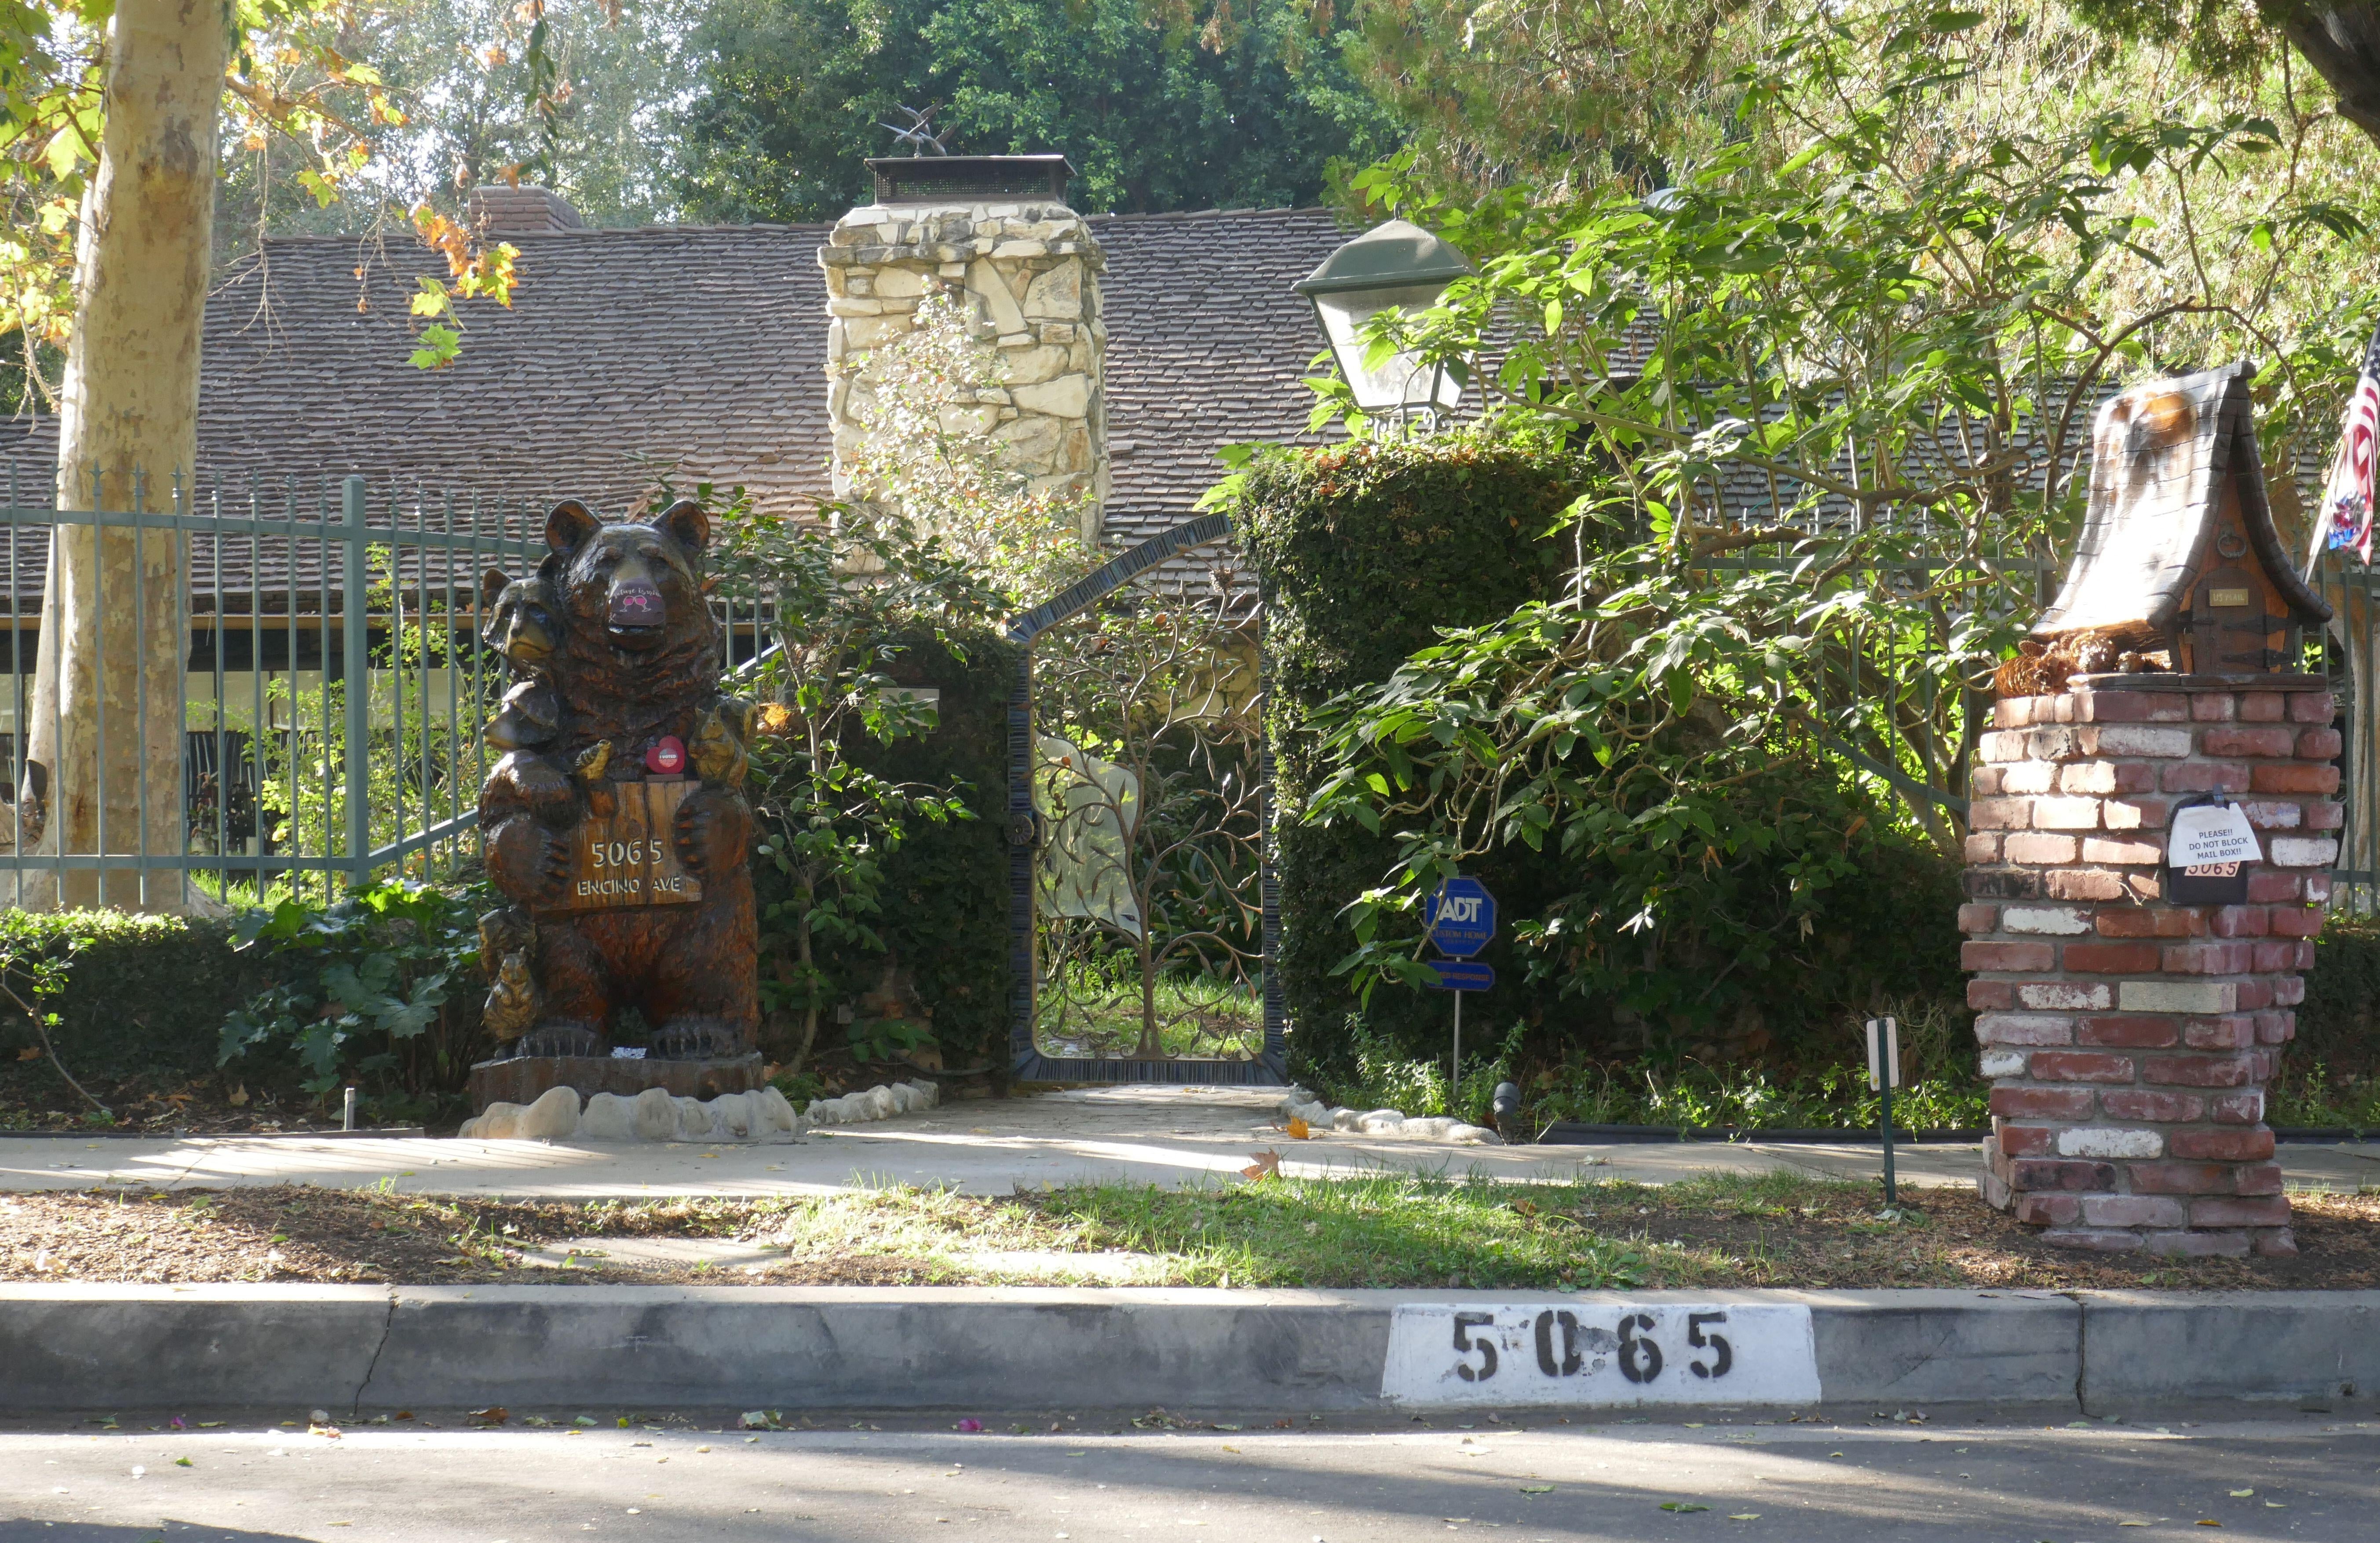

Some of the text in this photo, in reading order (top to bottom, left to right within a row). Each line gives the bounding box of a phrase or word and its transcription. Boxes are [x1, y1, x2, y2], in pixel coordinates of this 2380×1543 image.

[2226, 593, 2245, 602] MAIL
[2199, 829, 2233, 839] PLEASE!!
[2203, 840, 2219, 848] NOT
[2222, 837, 2249, 847] BLOCK
[591, 839, 663, 868] 5065
[2197, 848, 2241, 859] MAIL BOX!!
[2188, 861, 2238, 875] 5065
[577, 877, 680, 896] ENCINO AVE
[1438, 897, 1482, 922] ADT
[1431, 930, 1487, 940] CUSTOM HOME
[1453, 972, 1490, 981] RESPONSE
[1453, 1309, 1731, 1384] 5065
